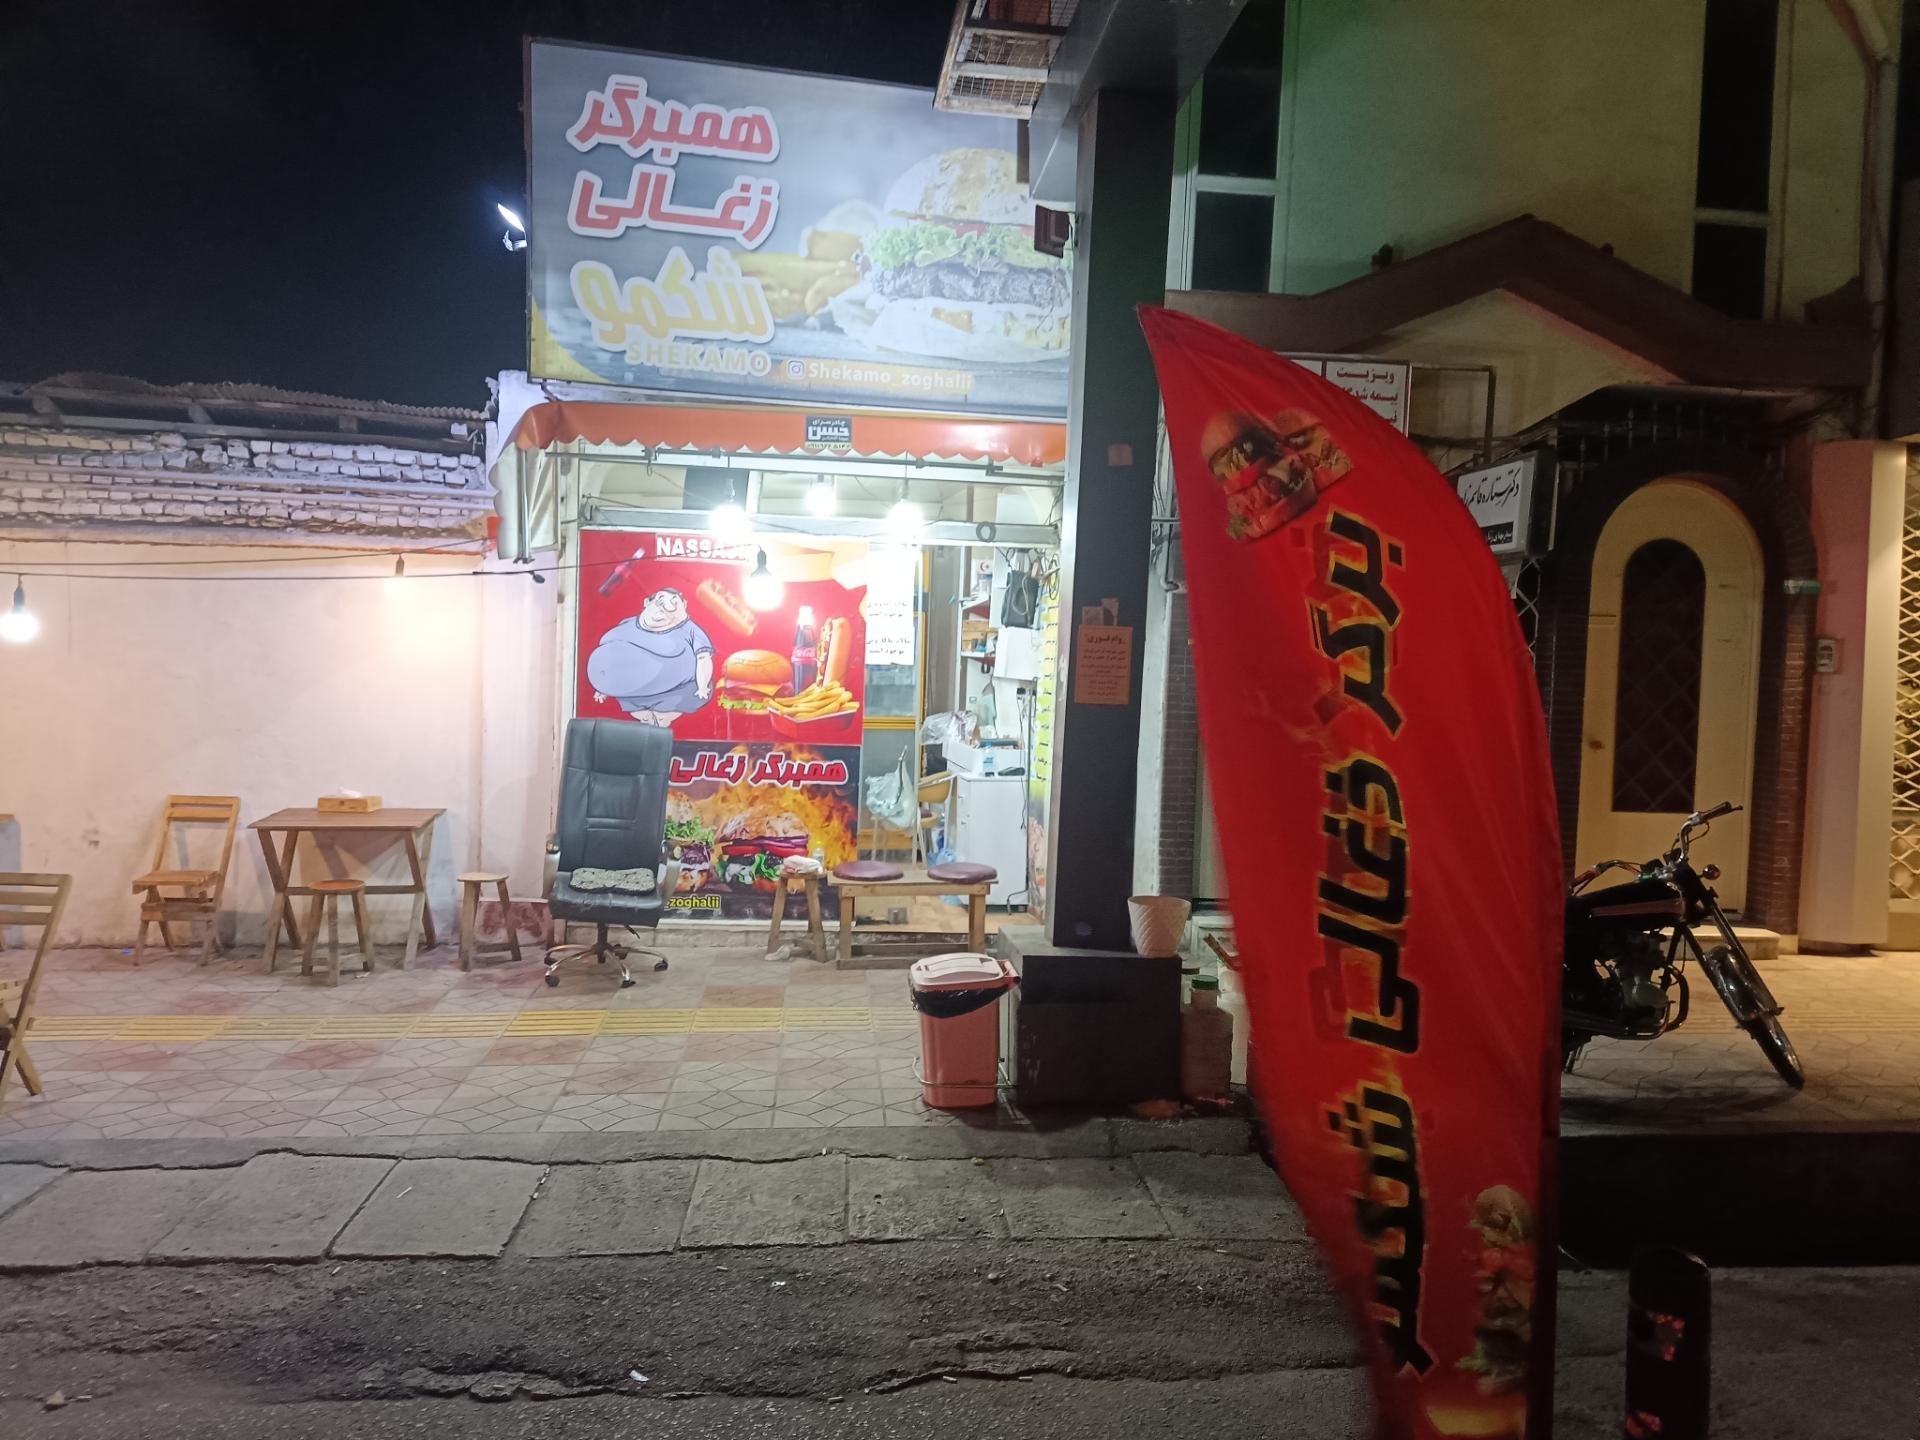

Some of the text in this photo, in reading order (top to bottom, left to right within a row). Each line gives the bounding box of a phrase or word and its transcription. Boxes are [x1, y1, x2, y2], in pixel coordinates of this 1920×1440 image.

[571, 81, 775, 159] همبرگر
[573, 171, 774, 243] زغالی
[577, 252, 770, 346] شکمو
[626, 343, 771, 374] SHEKAMO
[1336, 367, 1395, 384] ویزیت
[807, 425, 849, 440] حسن
[1309, 510, 1402, 736] برگر
[669, 753, 847, 787] همبرگر زغالی
[1317, 757, 1421, 1055] ذغالی
